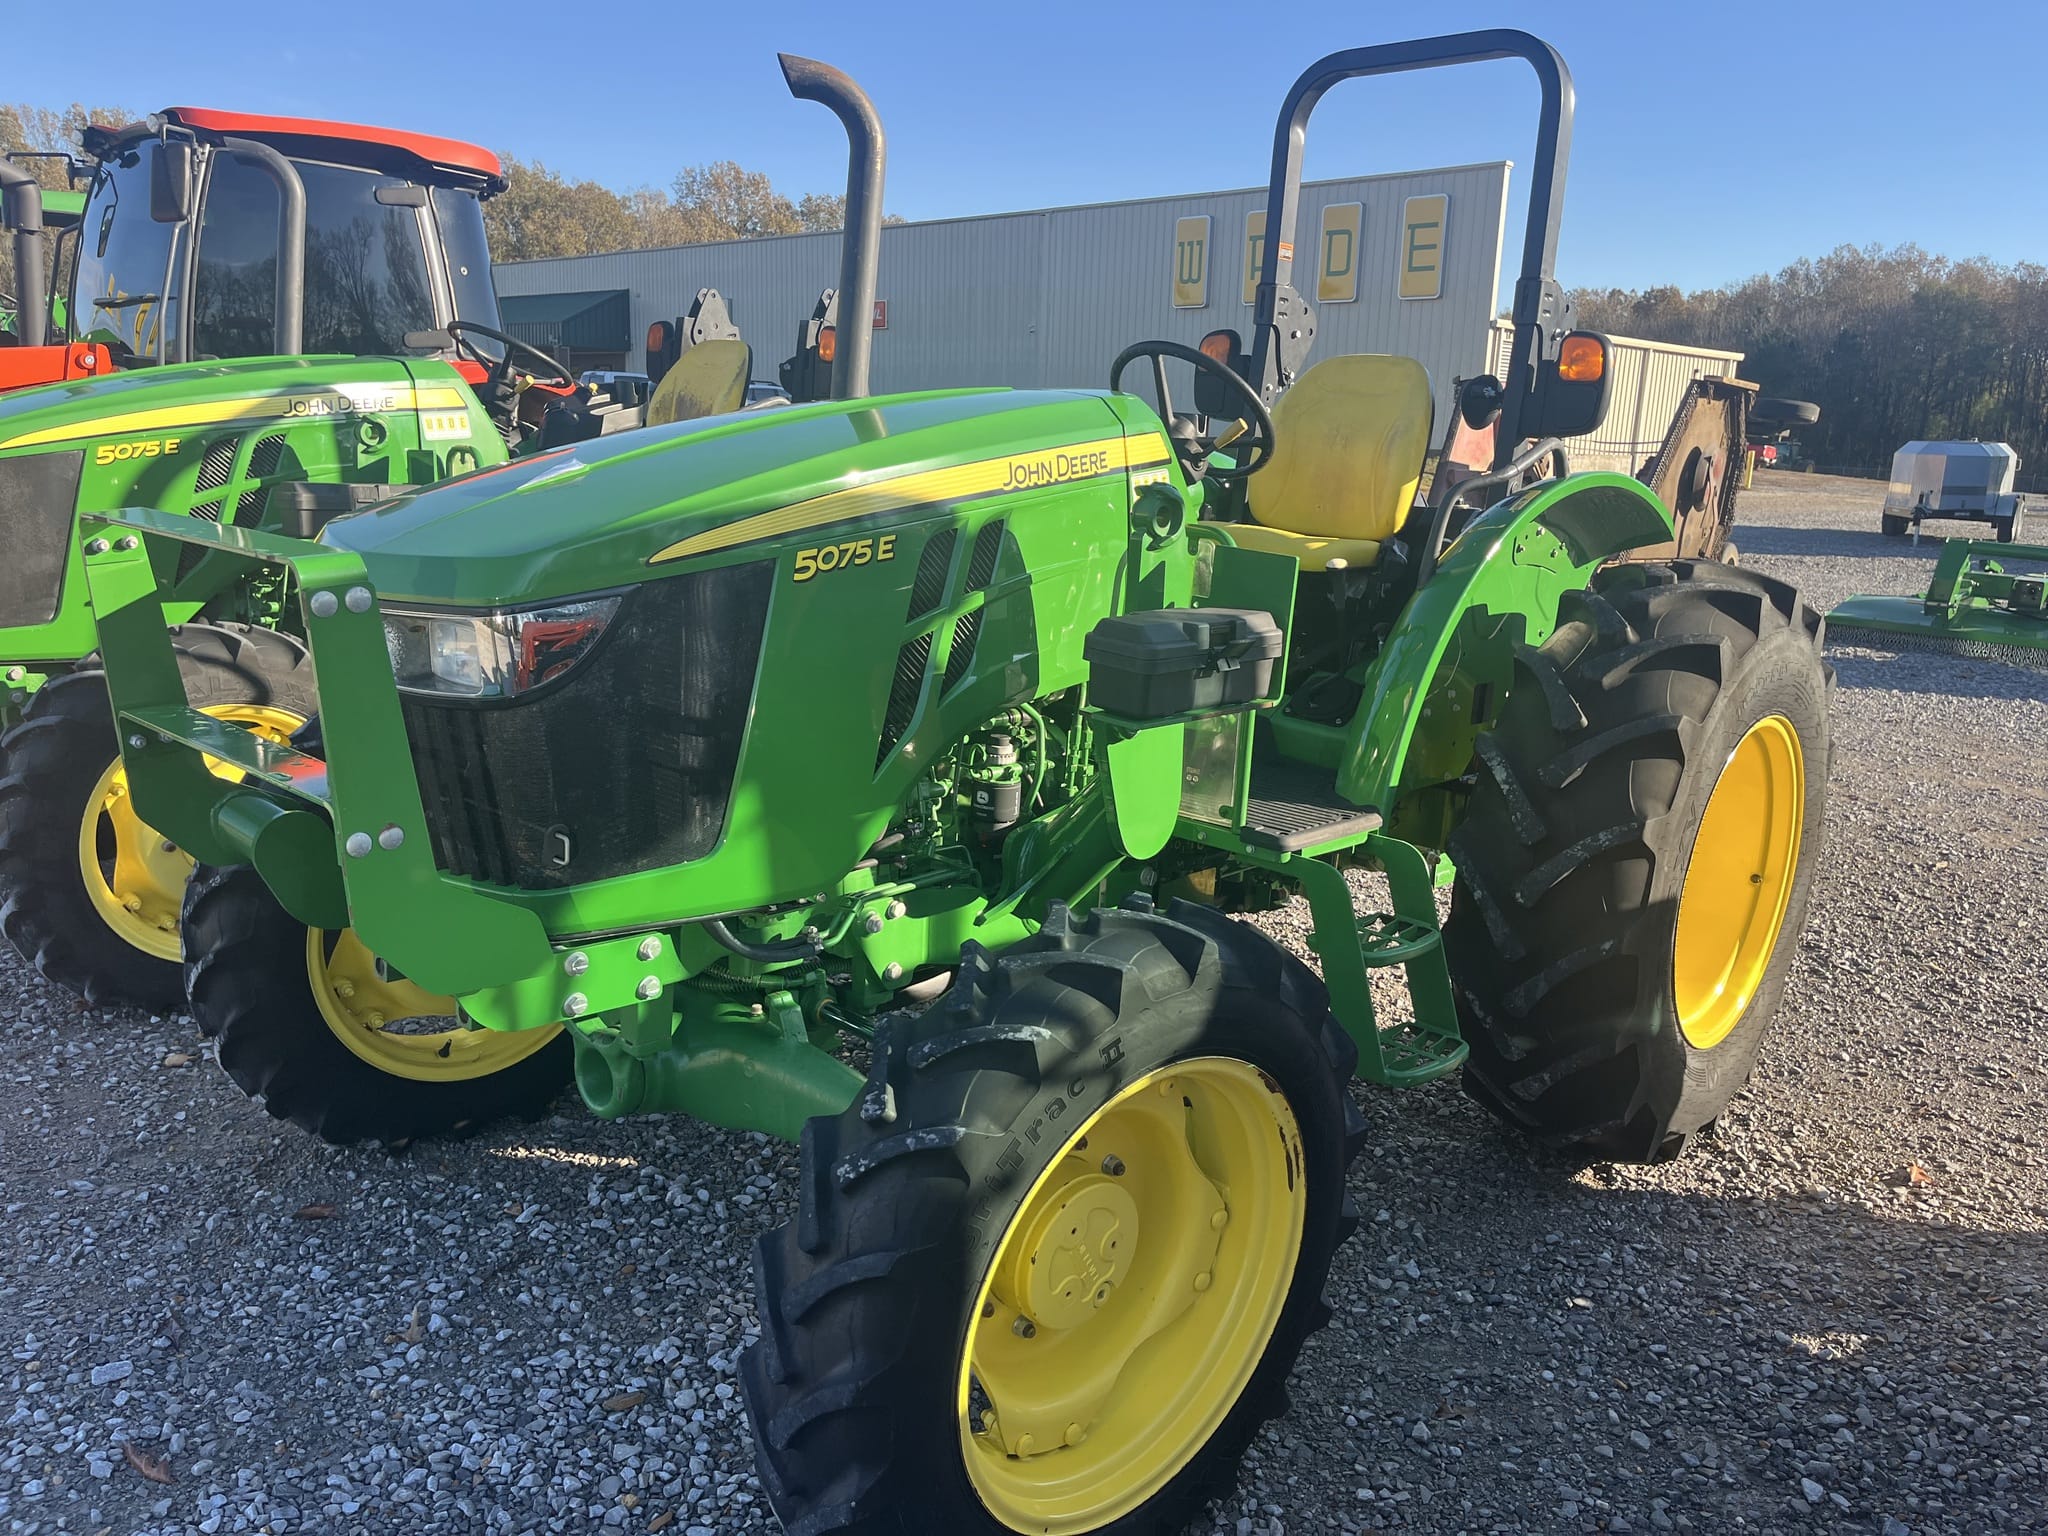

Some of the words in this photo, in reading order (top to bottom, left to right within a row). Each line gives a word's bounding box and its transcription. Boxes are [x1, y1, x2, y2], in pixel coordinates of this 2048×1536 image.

[283, 399, 334, 415] JOHN
[337, 396, 395, 412] DEERE
[96, 440, 161, 466] 5075
[164, 438, 181, 455] E
[1003, 460, 1053, 488] JOHN
[1057, 452, 1108, 478] DEERE
[793, 538, 873, 582] 5075
[877, 535, 897, 560] E
